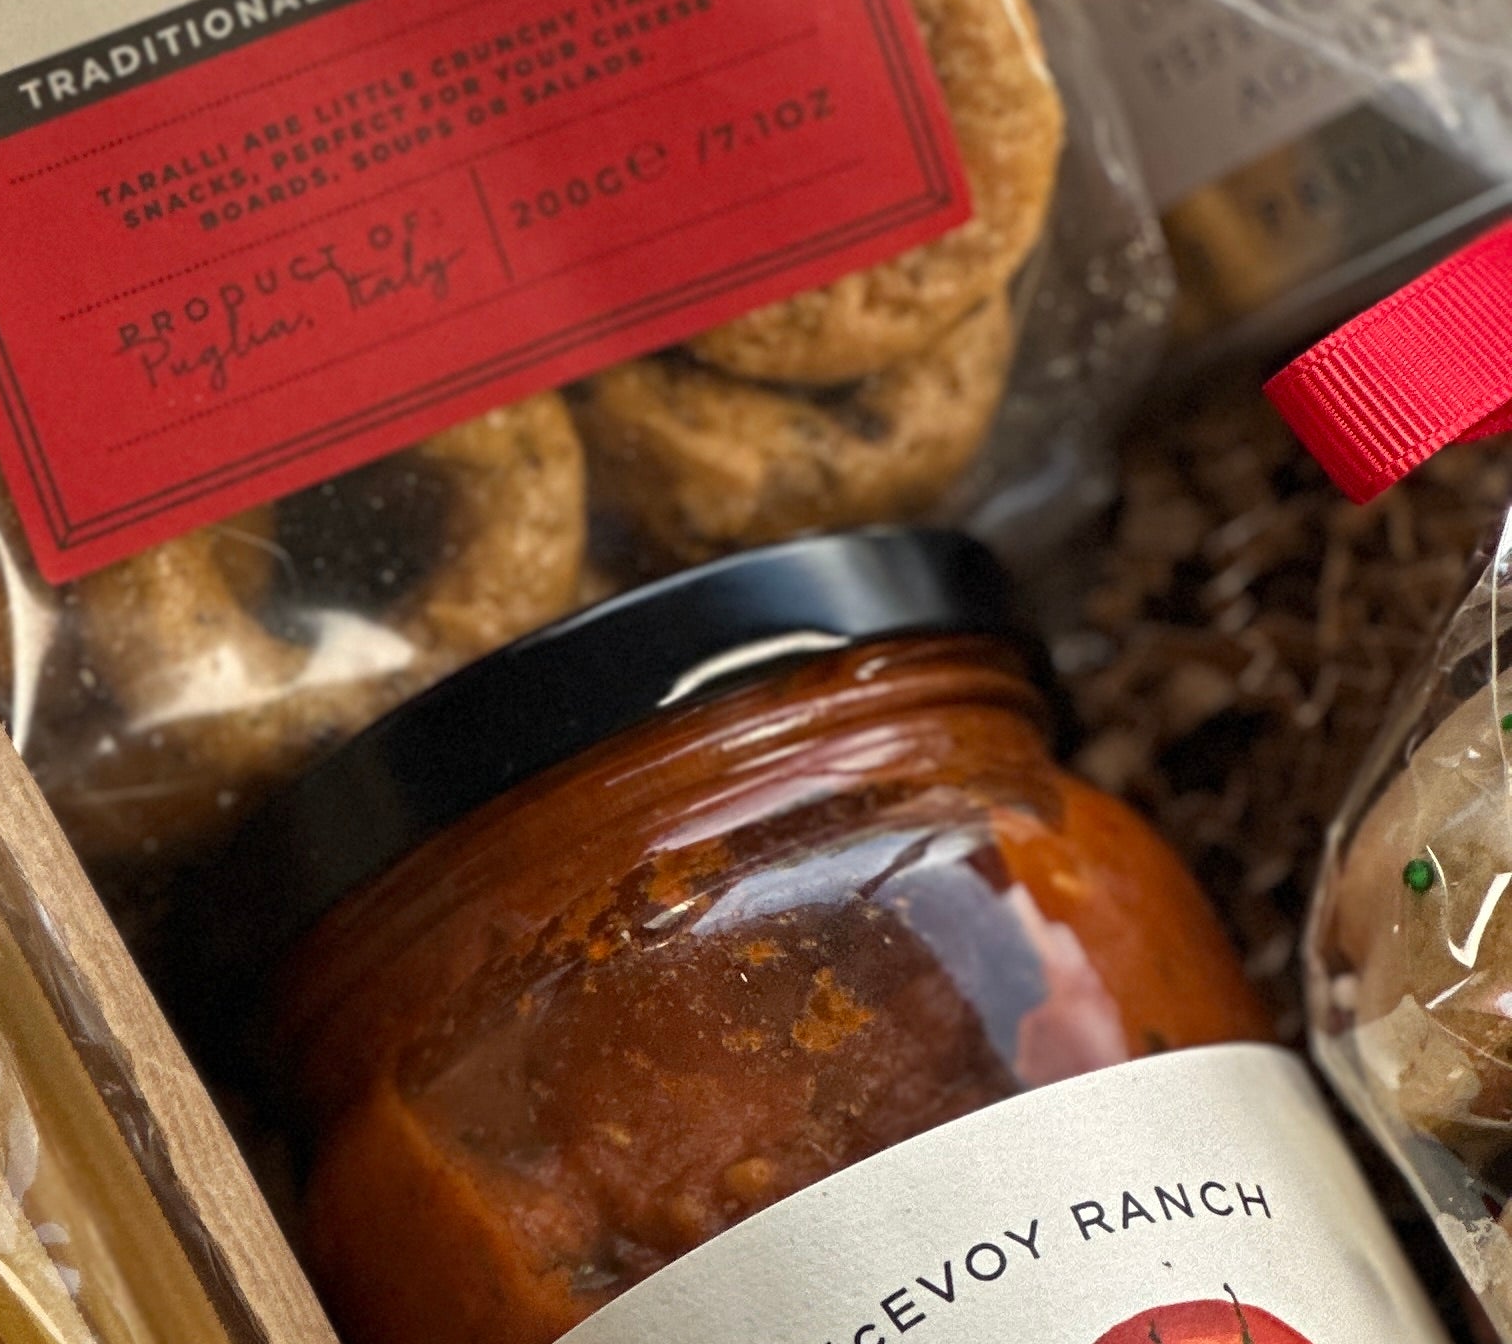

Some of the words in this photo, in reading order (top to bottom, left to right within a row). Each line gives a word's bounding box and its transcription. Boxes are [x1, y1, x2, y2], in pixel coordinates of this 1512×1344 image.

[97, 143, 229, 208] TARALLI
[243, 114, 302, 154] ARE
[314, 70, 416, 125] LITTLE
[431, 8, 577, 78] CRUNCHY
[123, 167, 260, 230] SNACKS,
[271, 104, 405, 172] PERFECT
[419, 75, 480, 113] FOR
[496, 39, 577, 85] YOUR
[351, 116, 454, 171] SOUPS
[465, 96, 507, 127] OR
[118, 243, 344, 348] PRODUCT
[1069, 1180, 1272, 1241] RANCH
